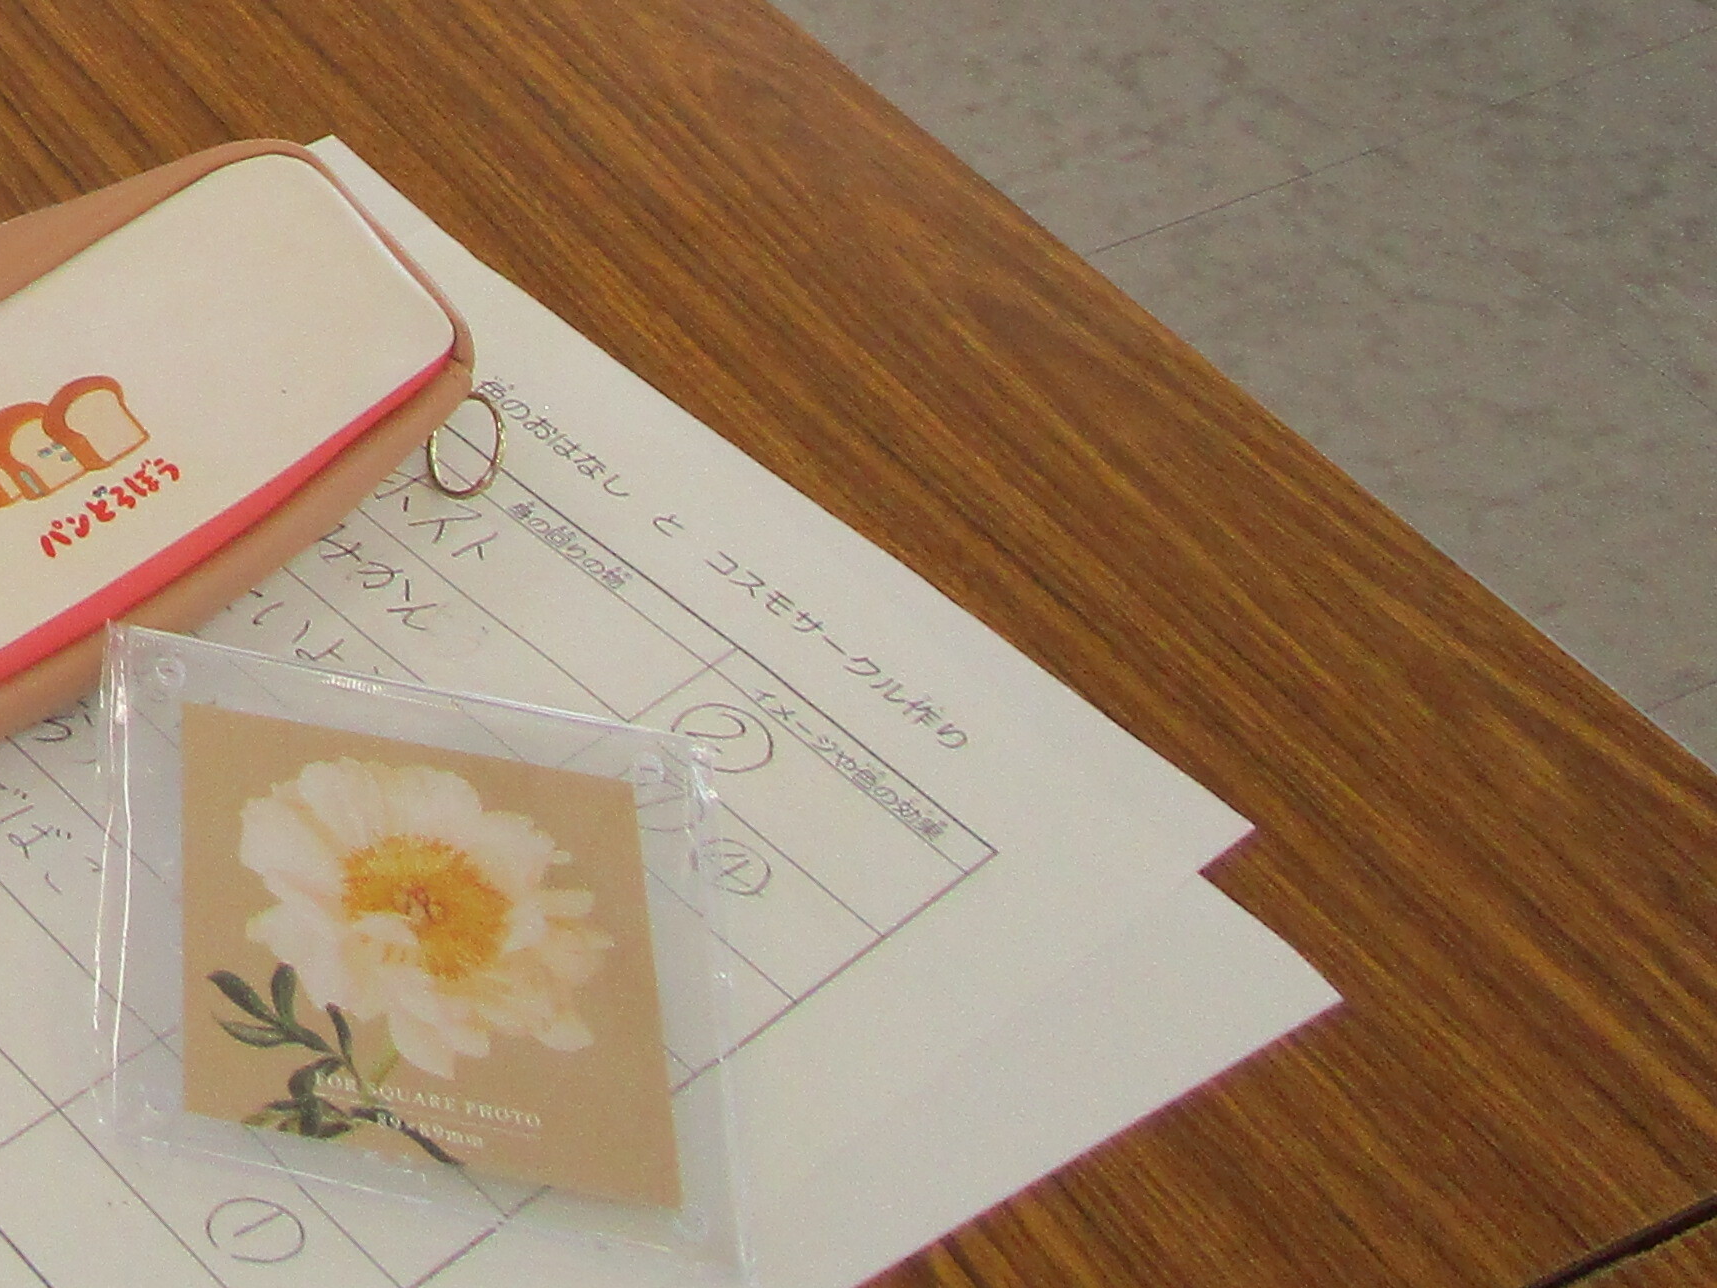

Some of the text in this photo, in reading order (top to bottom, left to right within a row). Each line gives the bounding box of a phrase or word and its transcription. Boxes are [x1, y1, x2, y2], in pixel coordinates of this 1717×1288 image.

[36, 455, 185, 560] パンどろぼう
[650, 510, 686, 535] と
[704, 548, 971, 752] コスモサークル作り
[463, 1098, 543, 1131] PHOTO
